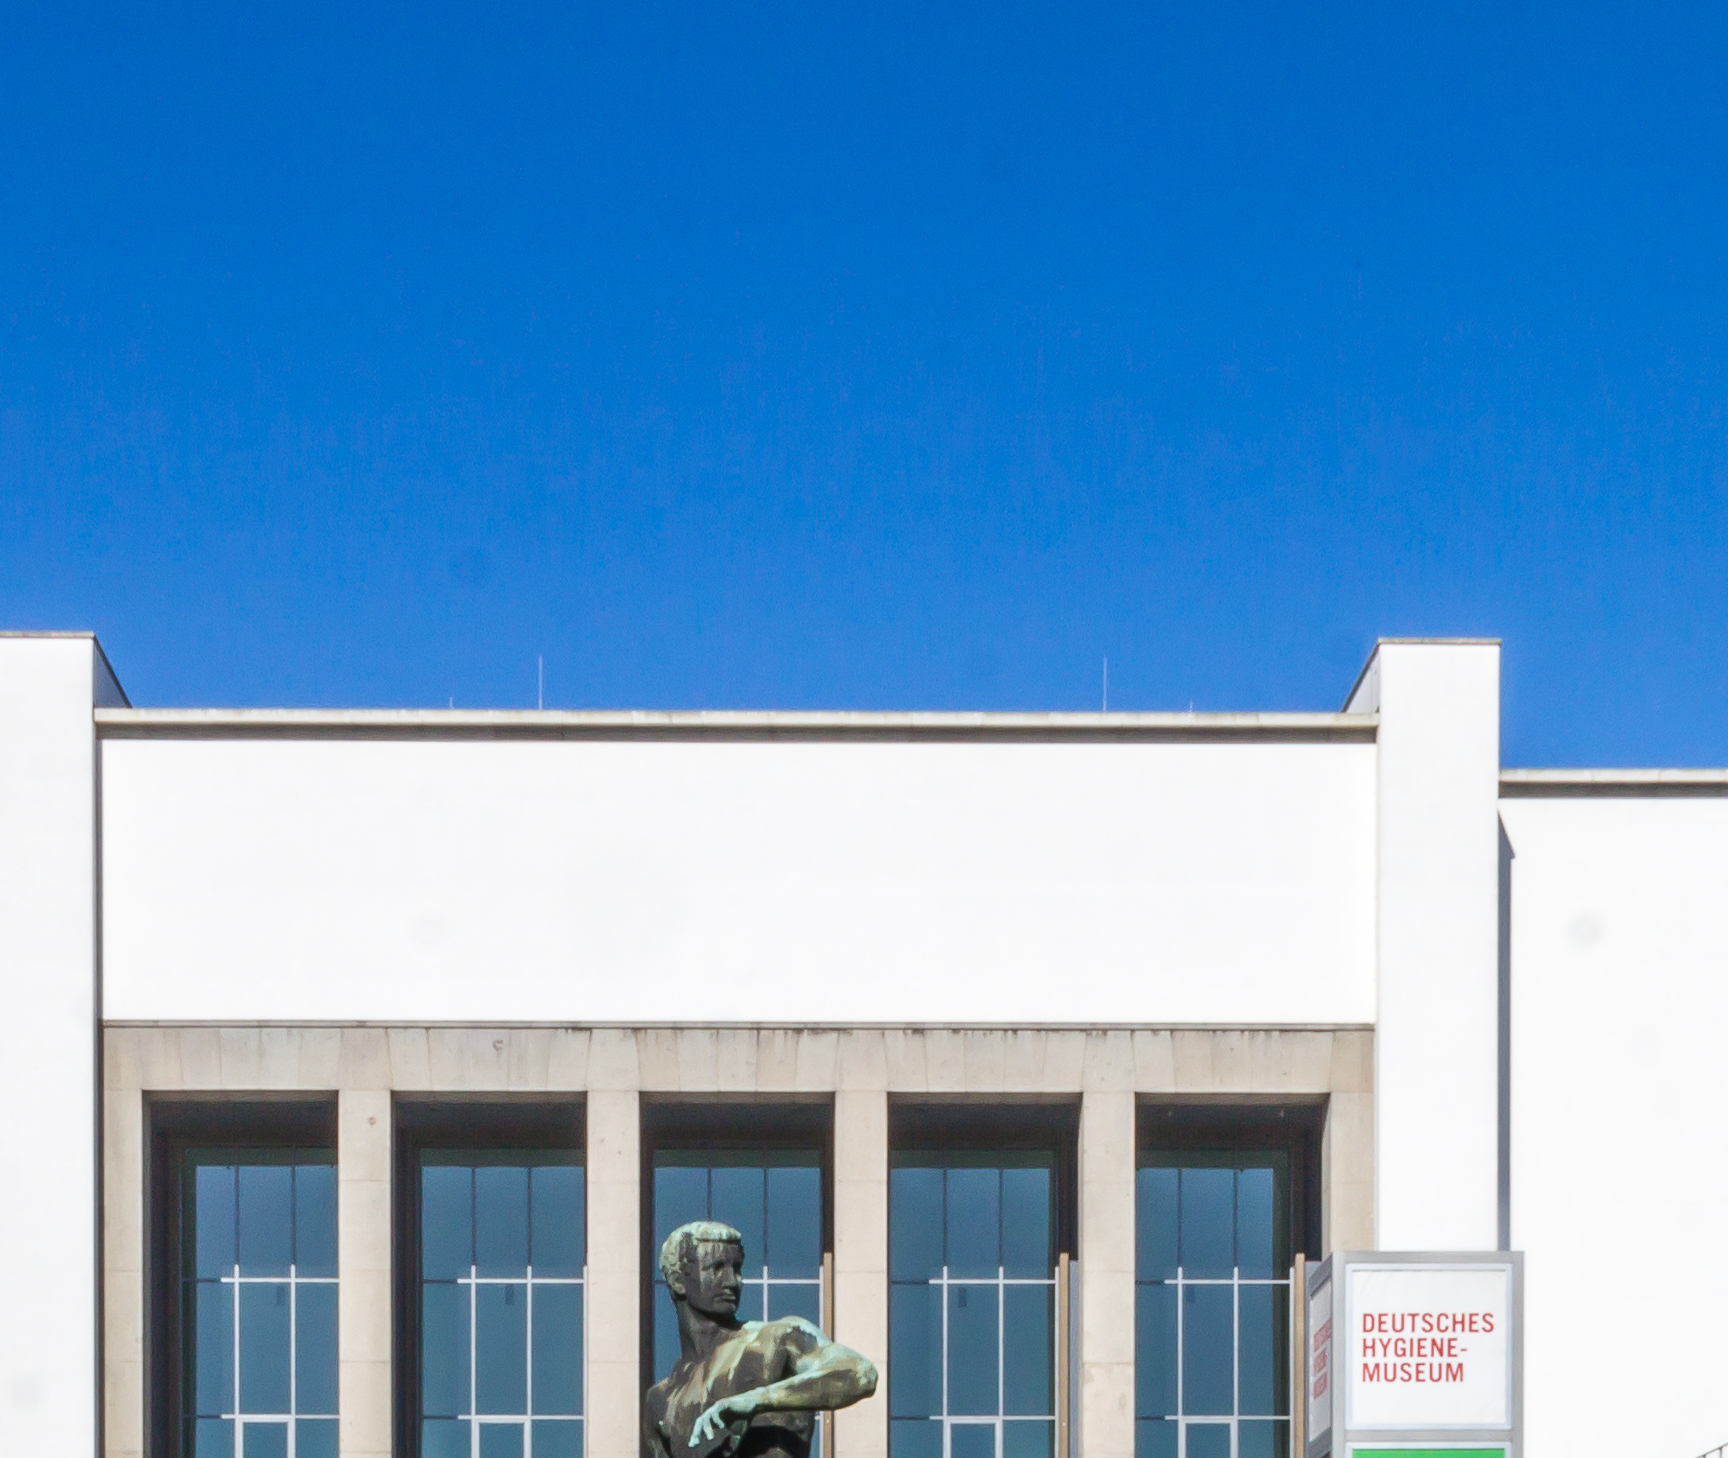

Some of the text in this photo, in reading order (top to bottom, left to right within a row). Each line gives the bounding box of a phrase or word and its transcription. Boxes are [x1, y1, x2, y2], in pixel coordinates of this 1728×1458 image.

[1362, 1313, 1494, 1333] DEUTSCHES
[1362, 1338, 1467, 1358] HYGIENE-
[1362, 1362, 1464, 1383] MUSEUM
